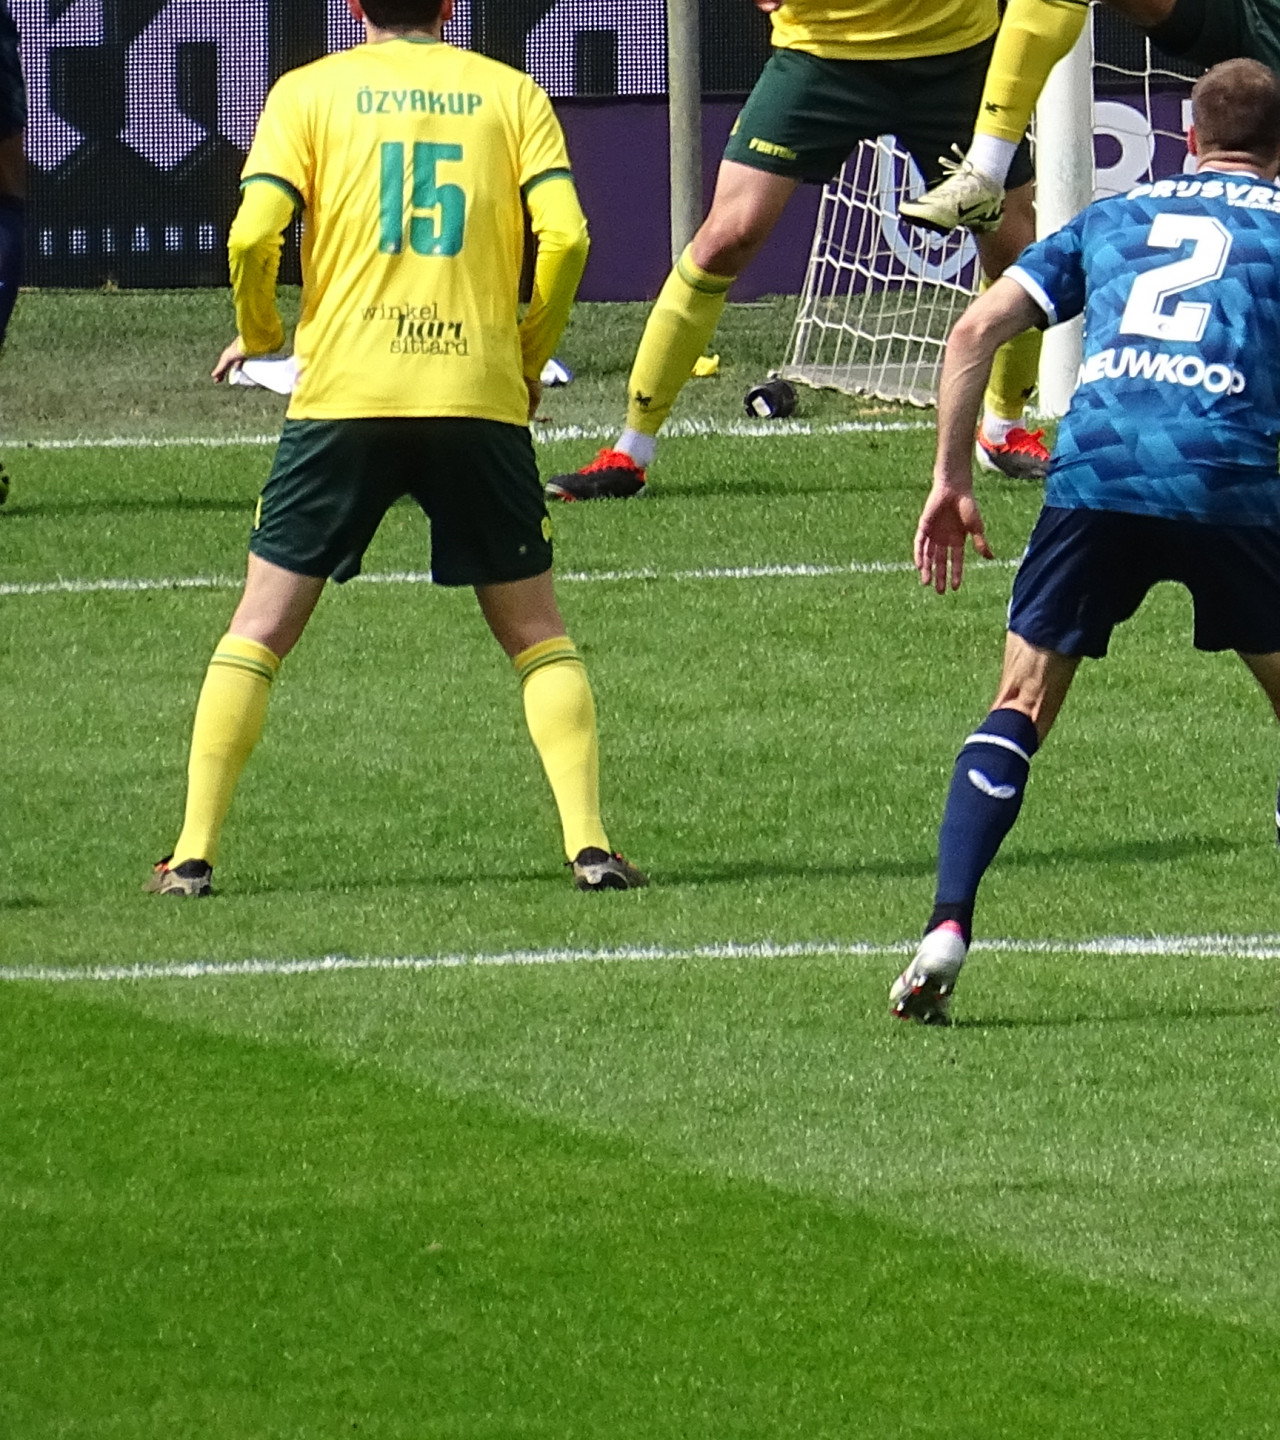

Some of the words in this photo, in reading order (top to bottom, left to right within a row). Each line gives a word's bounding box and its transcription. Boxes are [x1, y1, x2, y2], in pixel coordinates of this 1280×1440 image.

[356, 85, 484, 116] ÖZYAKUP
[377, 140, 467, 259] 15
[1119, 212, 1234, 343] 2
[361, 302, 439, 322] winkel
[390, 336, 470, 357] sittard
